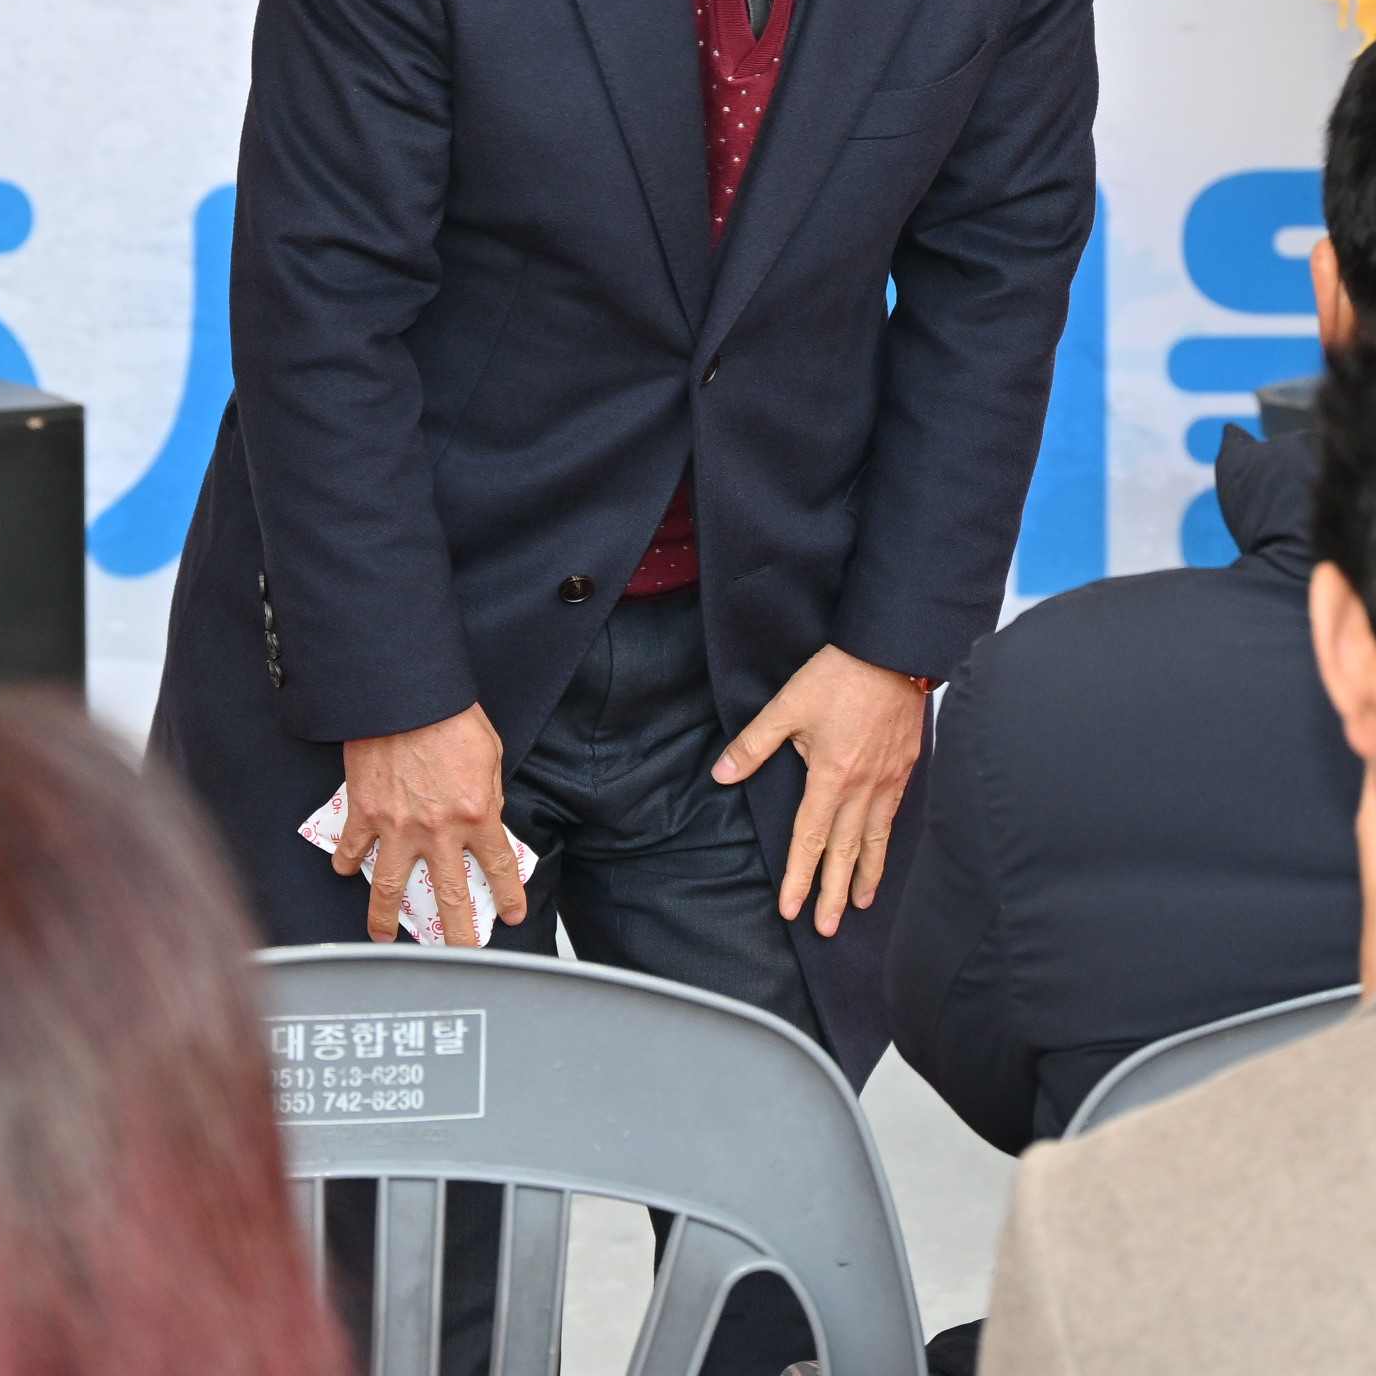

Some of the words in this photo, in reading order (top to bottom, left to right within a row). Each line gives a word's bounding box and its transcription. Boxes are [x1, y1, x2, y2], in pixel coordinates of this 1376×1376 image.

[271, 1018, 469, 1061] 대종합렌탈
[273, 1067, 315, 1090] 51)
[272, 1091, 315, 1114] 55)
[323, 1088, 424, 1113] 742-6230
